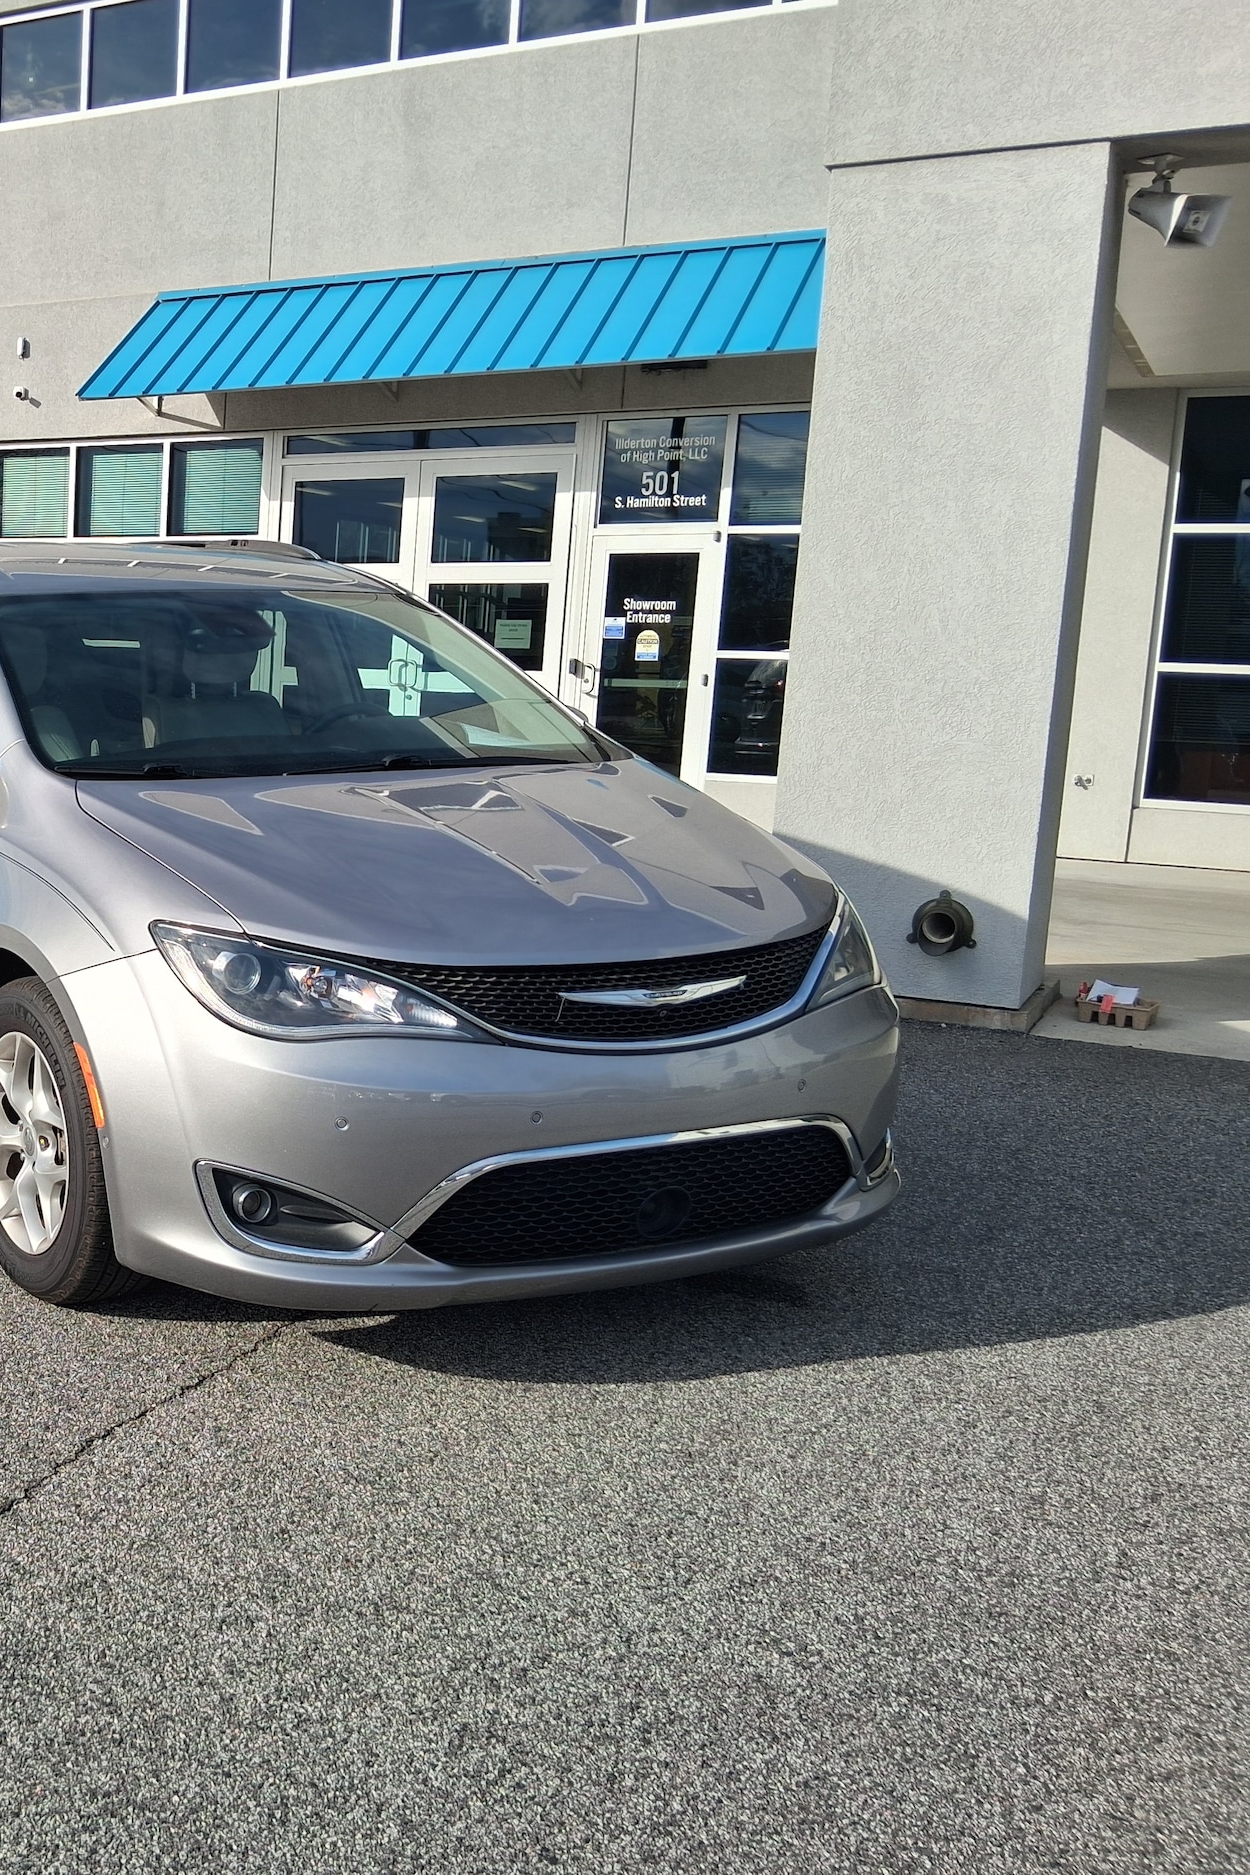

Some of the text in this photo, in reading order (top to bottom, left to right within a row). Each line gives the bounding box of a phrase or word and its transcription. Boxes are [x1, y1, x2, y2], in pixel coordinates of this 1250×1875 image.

[659, 434, 715, 449] Conversion
[620, 447, 708, 464] of High Point, LLC
[641, 471, 679, 495] 501
[614, 493, 707, 508] S. Hamilton Street
[623, 598, 676, 611] Showroom
[626, 611, 671, 624] Entrance
